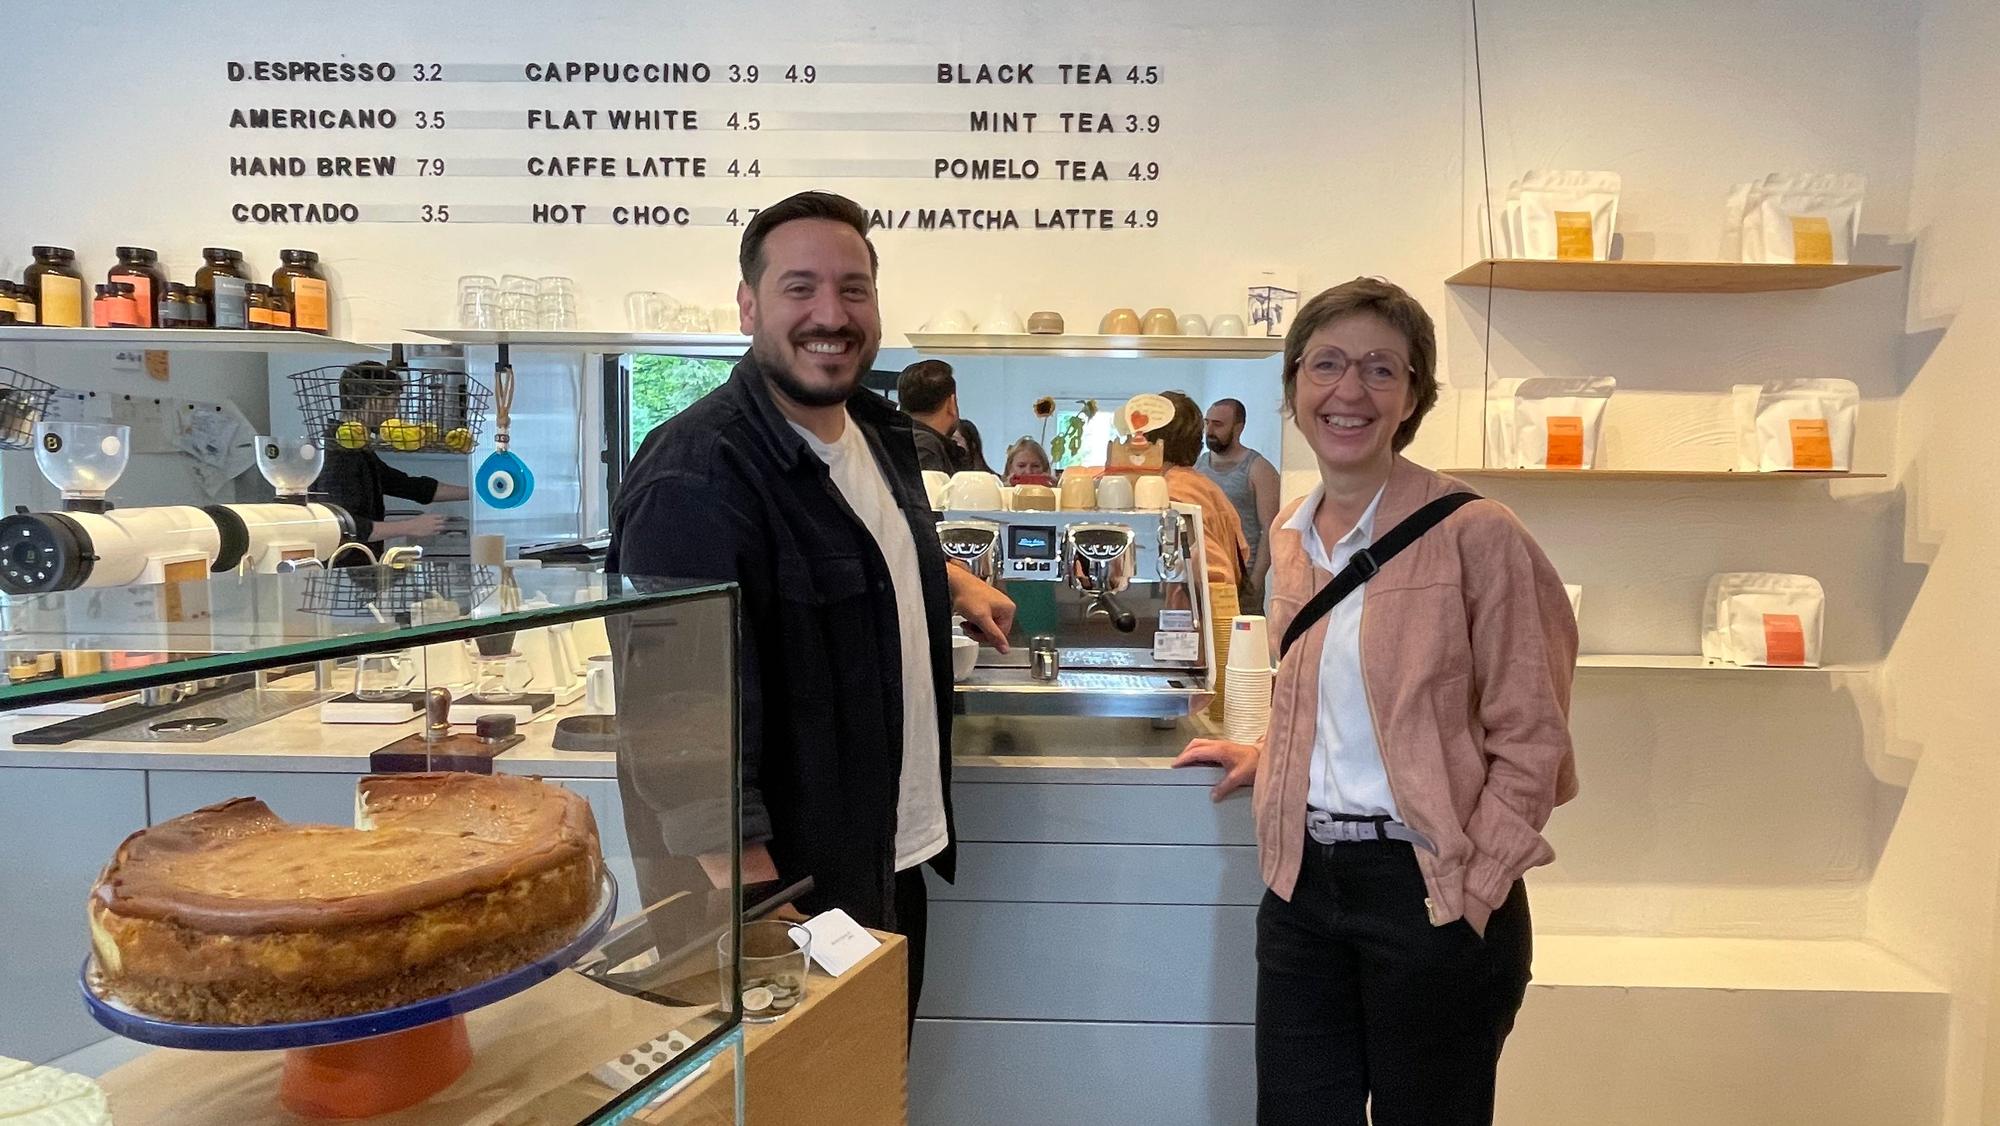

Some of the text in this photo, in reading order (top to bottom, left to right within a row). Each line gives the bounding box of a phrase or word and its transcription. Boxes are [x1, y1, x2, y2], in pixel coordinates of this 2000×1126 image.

[226, 61, 443, 83] D.ESPRESSO 3.2
[524, 61, 817, 84] CAPPUCCINO 3.9 4.9
[936, 62, 1158, 85] BLACK TEA 4.5
[228, 108, 446, 130] AMERICANO 3.5
[527, 109, 761, 131] FLAT WHITE 4.5
[970, 110, 1160, 134] MINT TEA 3.9
[229, 155, 445, 178] HAND BREW 7.9
[527, 156, 761, 178] CAFFE LATTE 4.4
[934, 158, 1160, 182] POMELO TEA 4.9
[231, 202, 450, 225] CORTADO 3.5
[532, 203, 587, 225] HOT
[612, 205, 690, 227] CHOC
[1034, 208, 1114, 232] LATTE
[1123, 209, 1159, 229] 4.9
